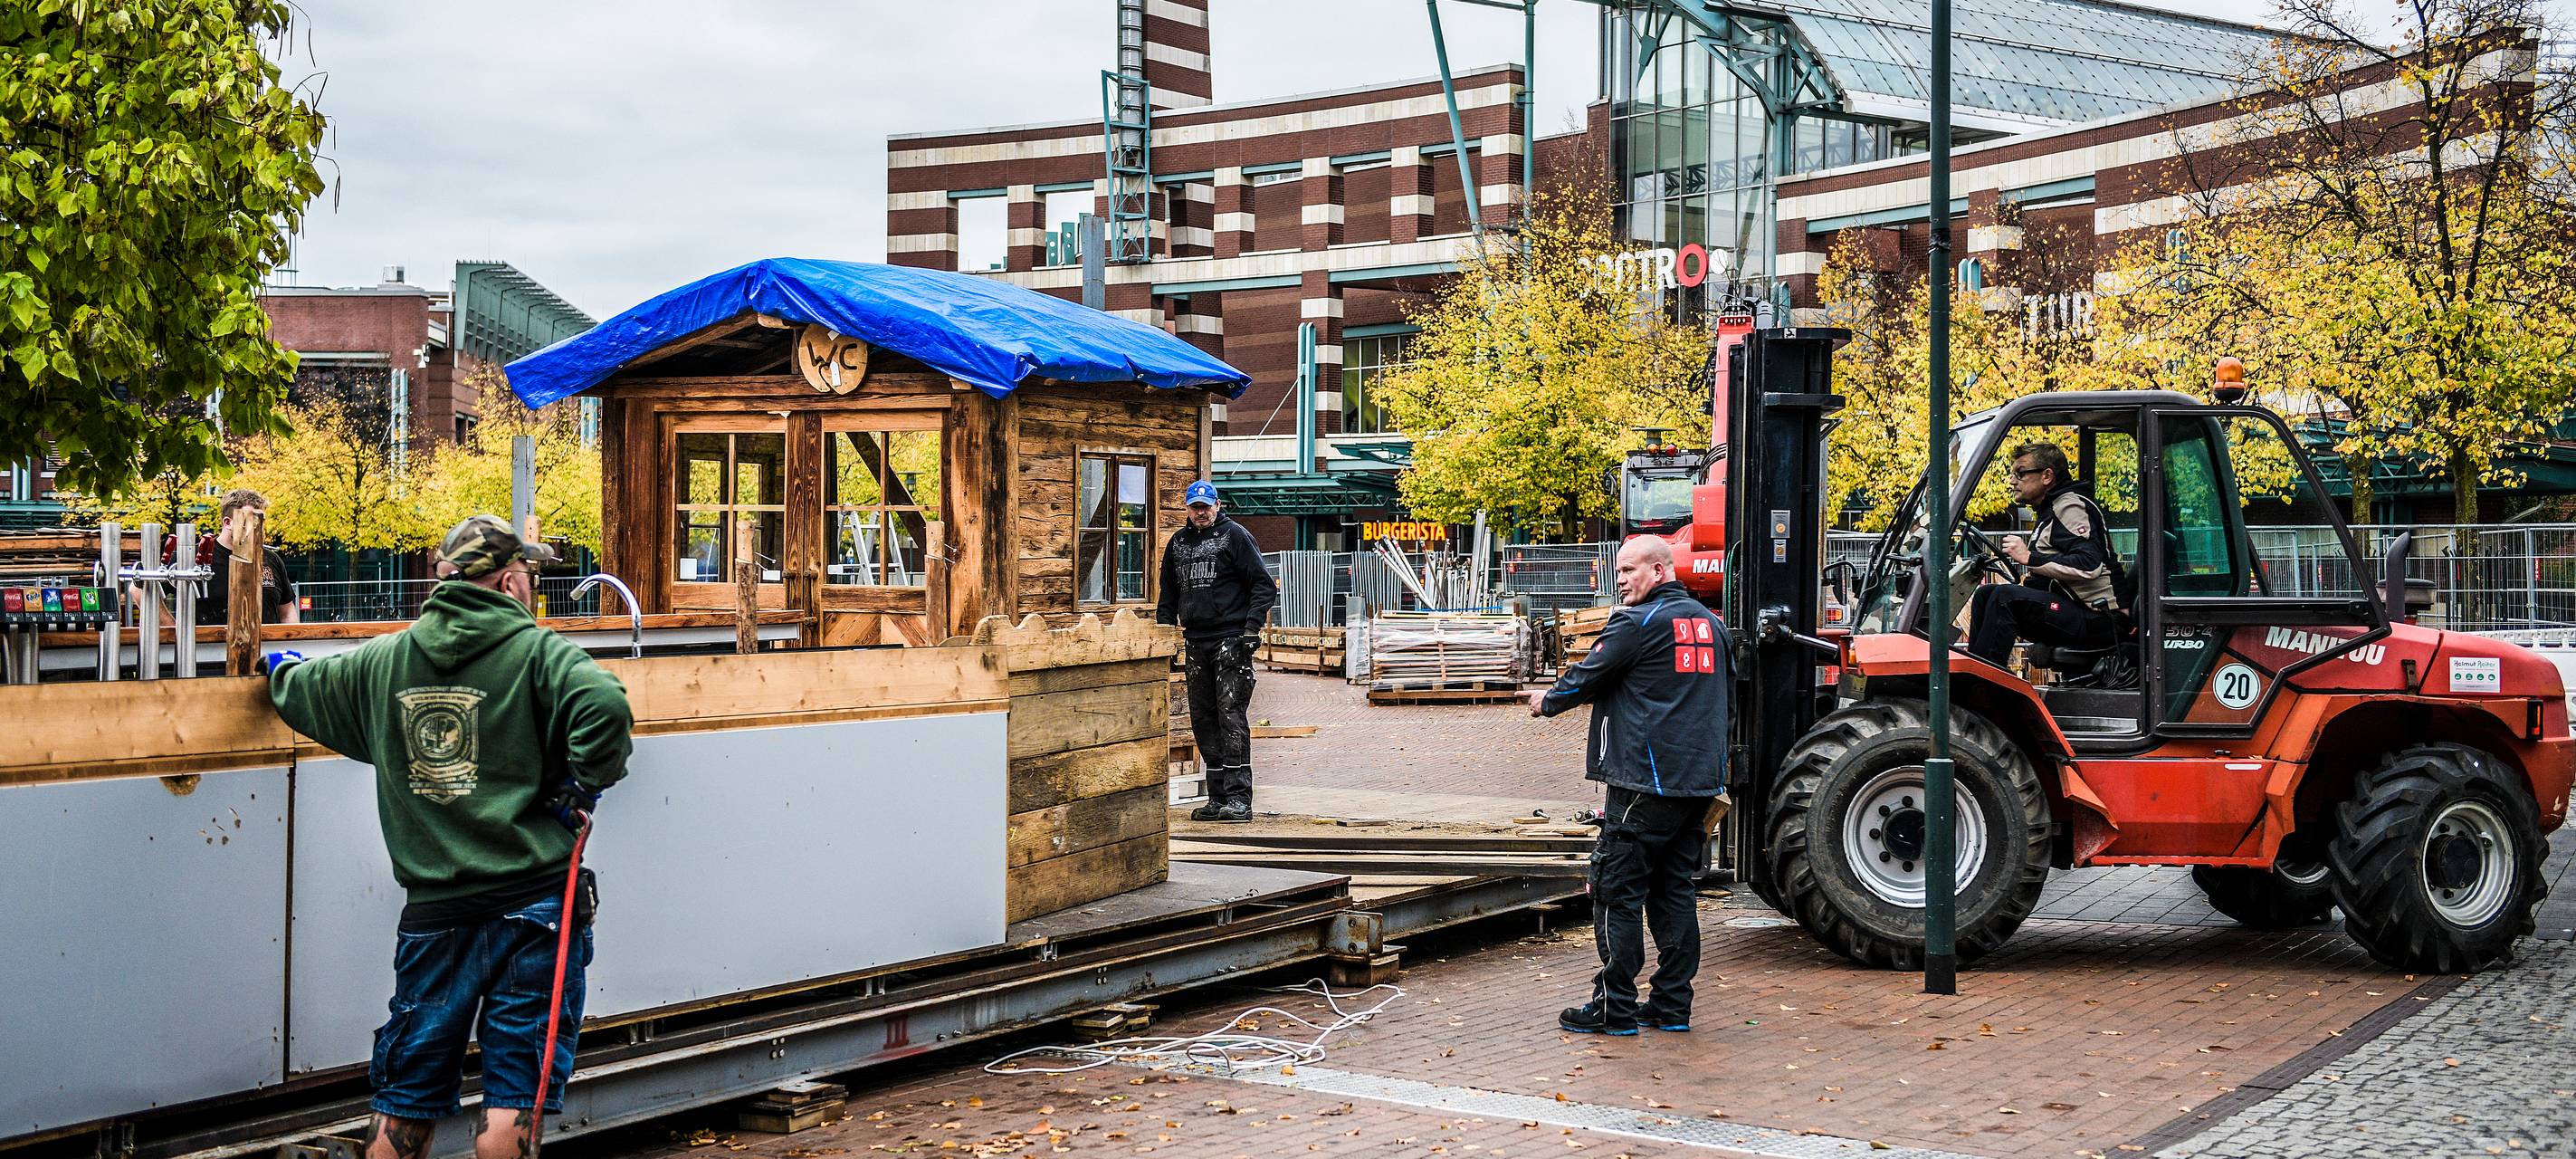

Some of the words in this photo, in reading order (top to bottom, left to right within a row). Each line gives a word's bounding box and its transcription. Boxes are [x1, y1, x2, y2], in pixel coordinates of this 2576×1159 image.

[806, 341, 858, 370] WC
[1362, 521, 1446, 541] BURGERISTA
[2163, 639, 2205, 649] URBO
[2223, 672, 2250, 701] 20
